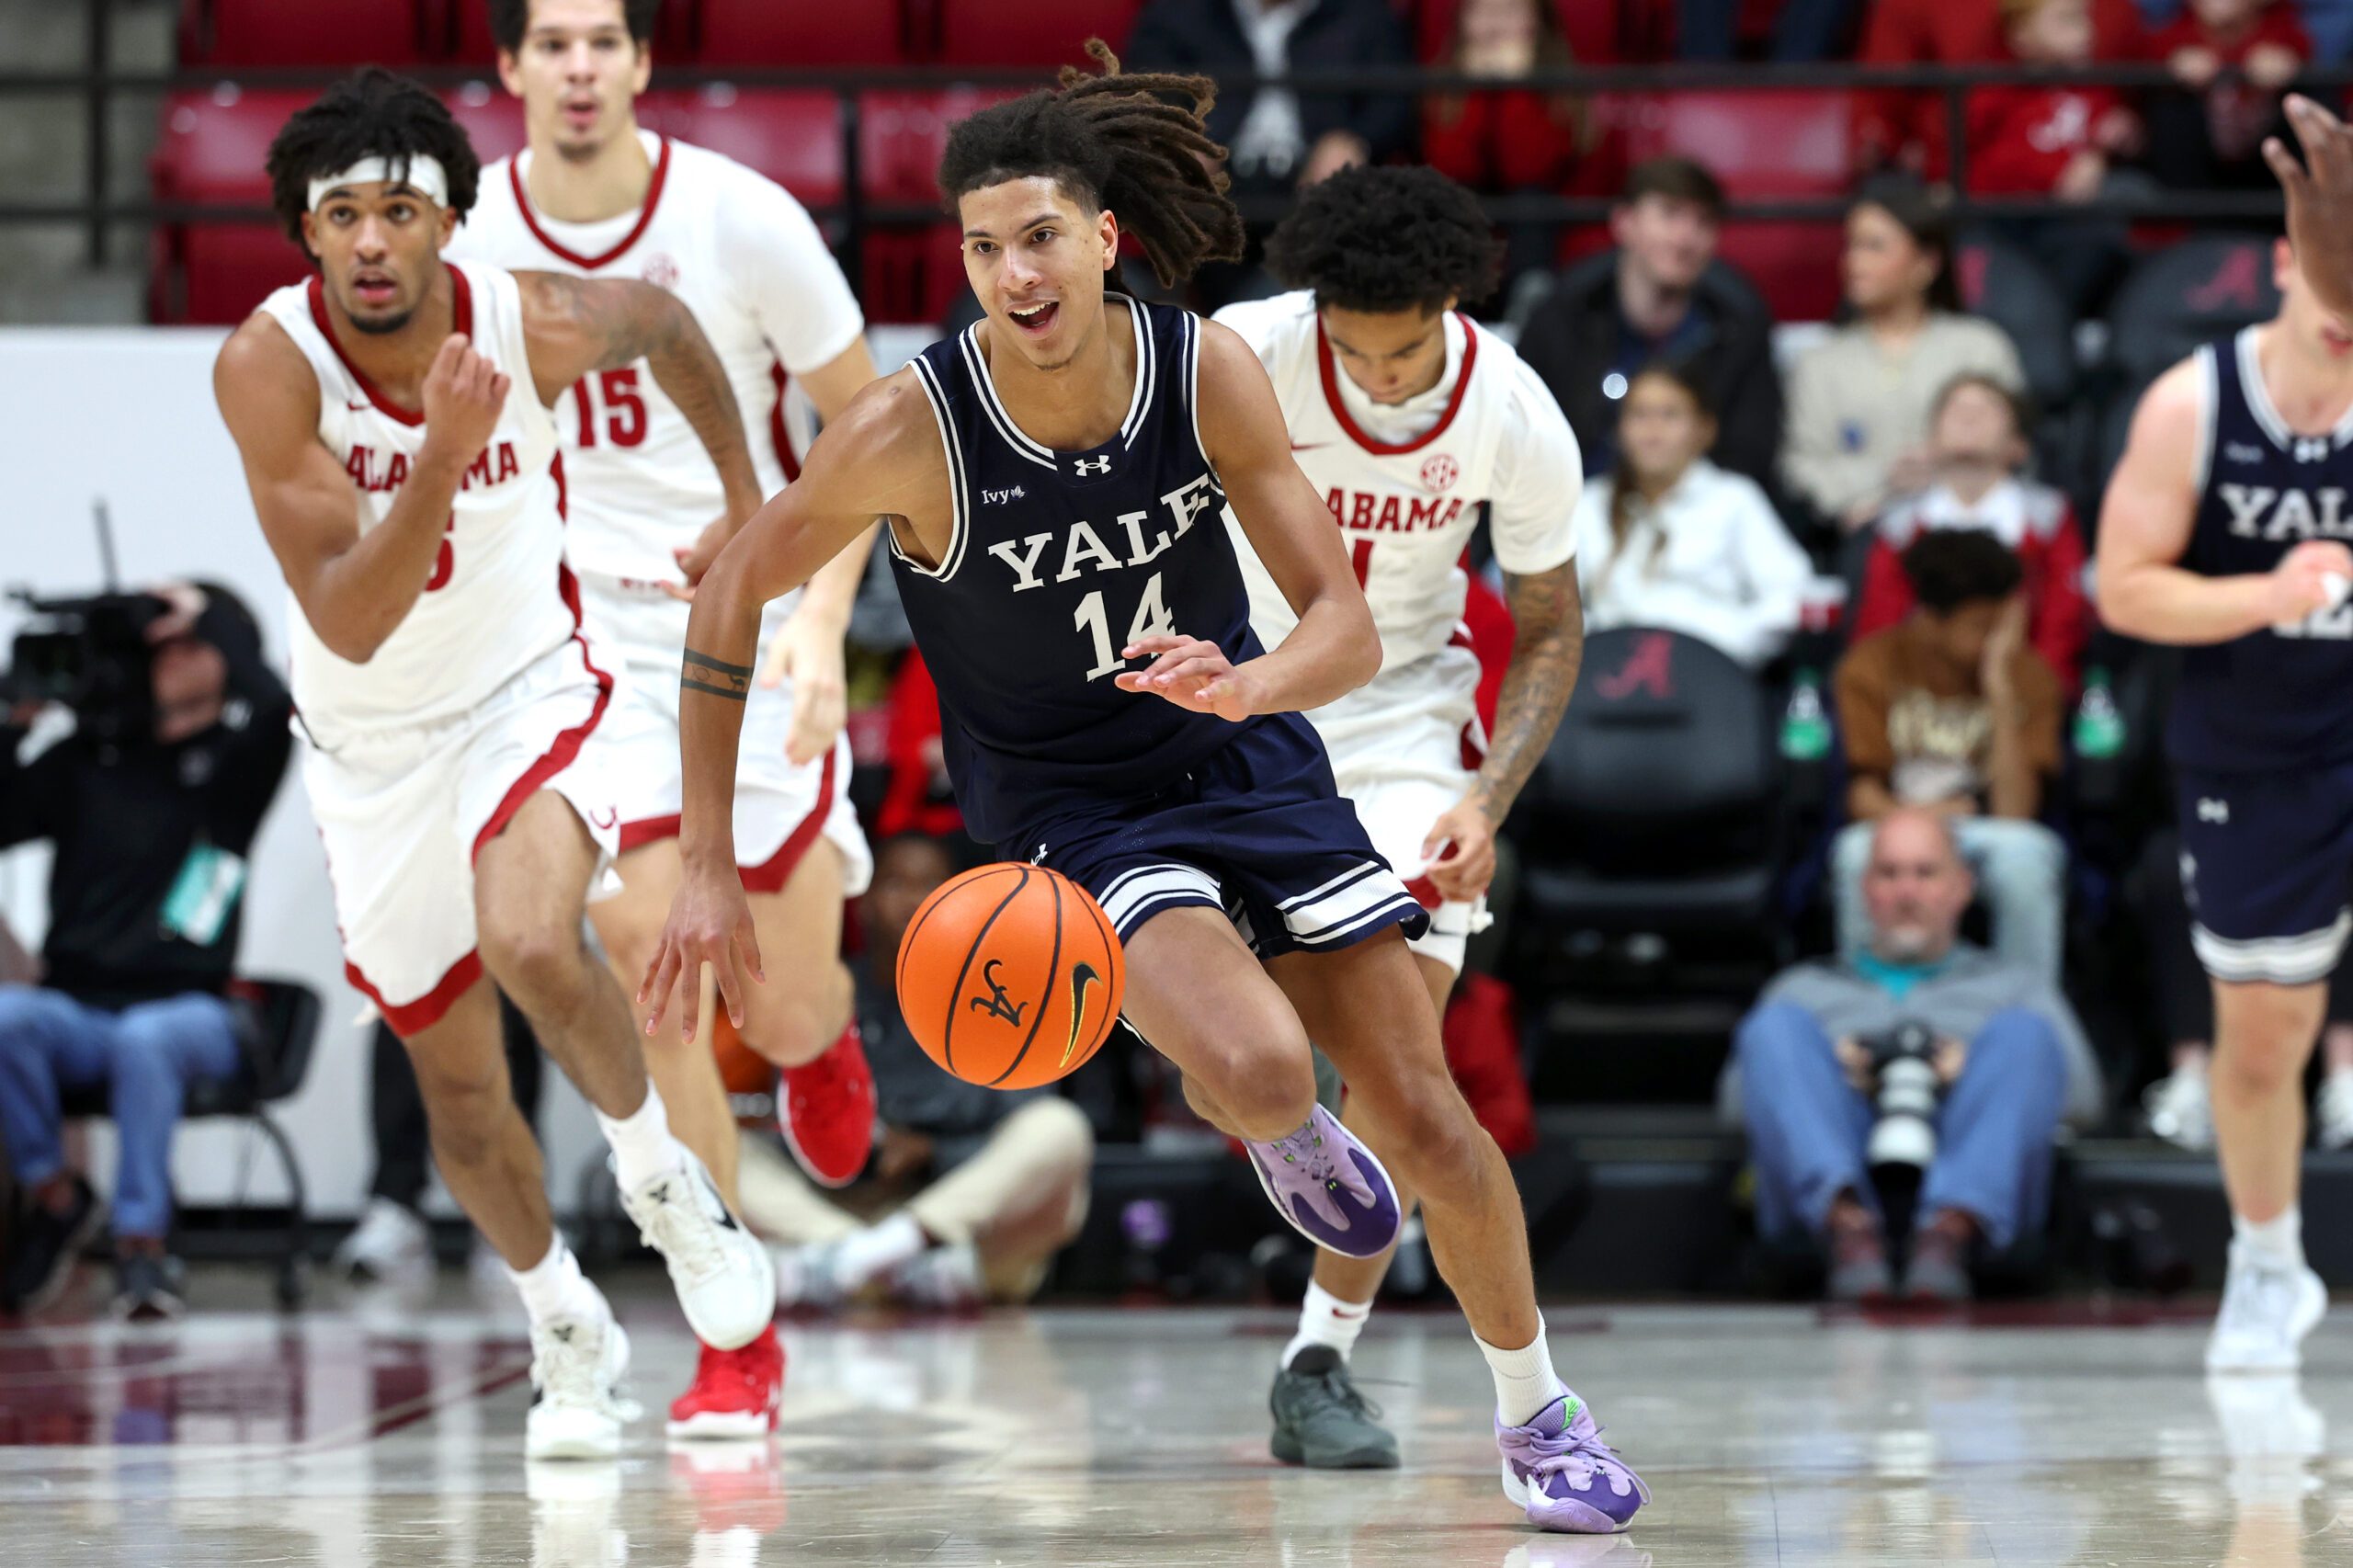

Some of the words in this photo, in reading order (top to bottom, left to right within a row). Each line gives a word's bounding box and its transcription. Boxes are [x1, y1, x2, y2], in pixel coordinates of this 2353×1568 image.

[573, 369, 647, 448] 15
[346, 442, 519, 492] ALAMA
[981, 489, 1009, 505] Ivy
[987, 472, 1210, 592] YALE
[1326, 487, 1463, 531] ABAMA
[1074, 571, 1176, 683] 14
